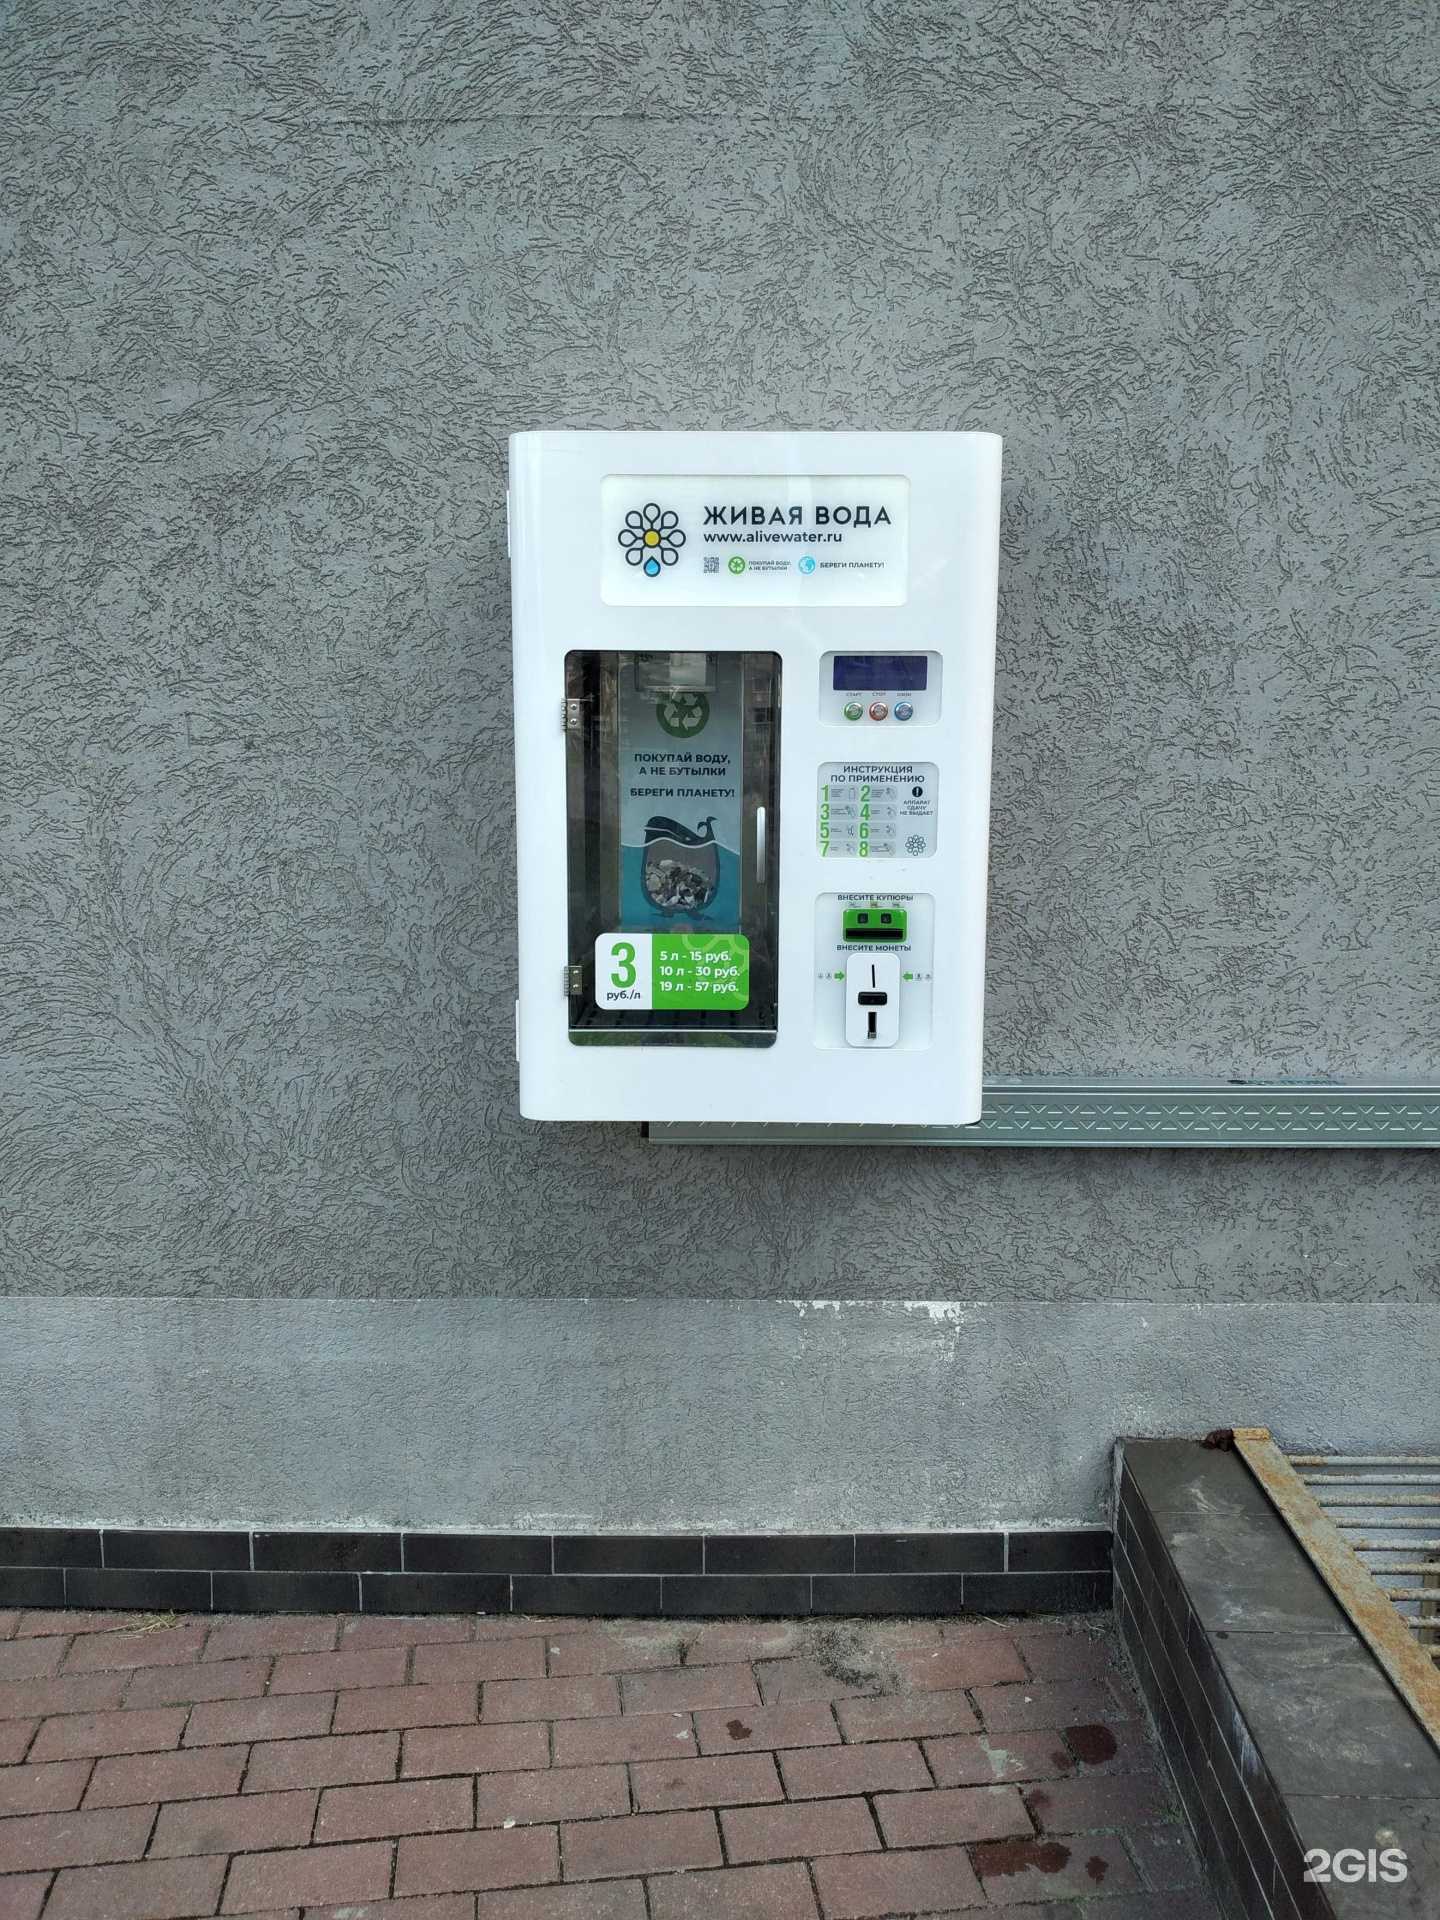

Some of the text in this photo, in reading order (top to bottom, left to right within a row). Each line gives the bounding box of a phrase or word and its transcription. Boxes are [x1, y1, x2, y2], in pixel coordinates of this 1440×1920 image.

[703, 506, 892, 528] ЖИВАЯ ВОДА
[703, 531, 843, 543] www.alivewater.ru
[634, 752, 731, 764] ПОКУПАЙ ВОДУ,
[639, 767, 726, 776] А НЕ БУТЫЛКИ
[843, 766, 913, 774] ИНСТРУКЦИЯ
[831, 775, 925, 783] ПО ПРИМЕНЕНИЮ
[630, 787, 735, 798] БЕРЕГИ ПЛАНЕТУ!
[821, 785, 829, 802] 1
[860, 785, 870, 802] 2
[820, 804, 830, 820] 3
[860, 804, 870, 821] 4
[820, 823, 830, 839] 5
[860, 823, 869, 839] 6
[820, 841, 829, 857] 7
[860, 841, 868, 857] 8
[660, 951, 667, 961] 5
[671, 953, 678, 961] л
[690, 951, 701, 961] 15
[706, 951, 731, 964] руб.
[611, 942, 637, 988] 3
[660, 966, 673, 977] 10
[676, 969, 684, 977] л
[696, 966, 711, 977] 30
[715, 966, 740, 979] руб.
[660, 981, 672, 992] 19
[675, 984, 683, 992] л
[695, 981, 709, 992] 57
[713, 981, 738, 994] руб.
[606, 990, 641, 1001] руб./л
